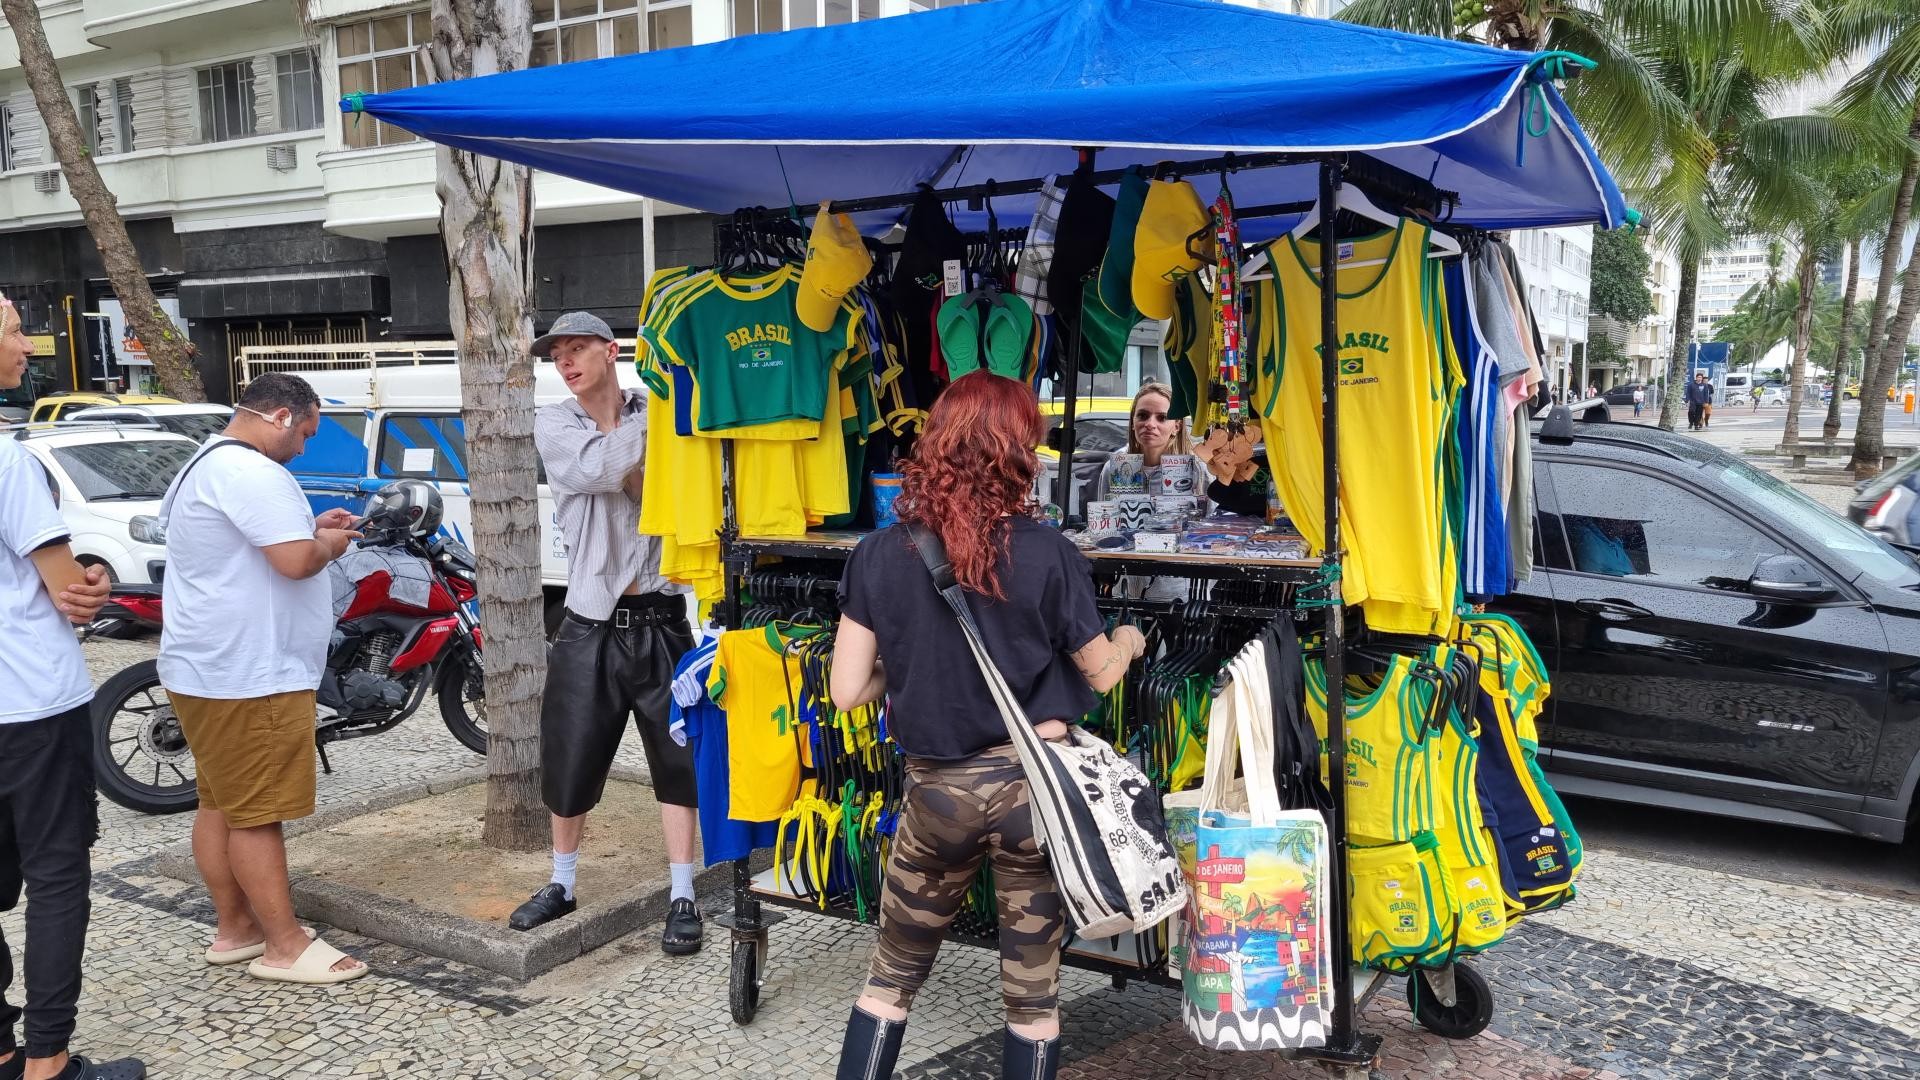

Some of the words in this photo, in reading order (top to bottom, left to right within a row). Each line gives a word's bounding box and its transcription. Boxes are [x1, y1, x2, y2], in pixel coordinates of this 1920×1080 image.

[725, 324, 791, 351] BRASIL
[1313, 332, 1389, 360] ASIL
[1351, 377, 1379, 385] JANEIRO
[1109, 828, 1128, 847] 68
[1526, 845, 1557, 861] BRASIL
[1201, 866, 1212, 875] DE
[1213, 863, 1243, 876] JANEIRO
[1389, 901, 1419, 914] BRASIL
[1465, 898, 1497, 914] BRASIL
[1200, 977, 1224, 990] LAPA
